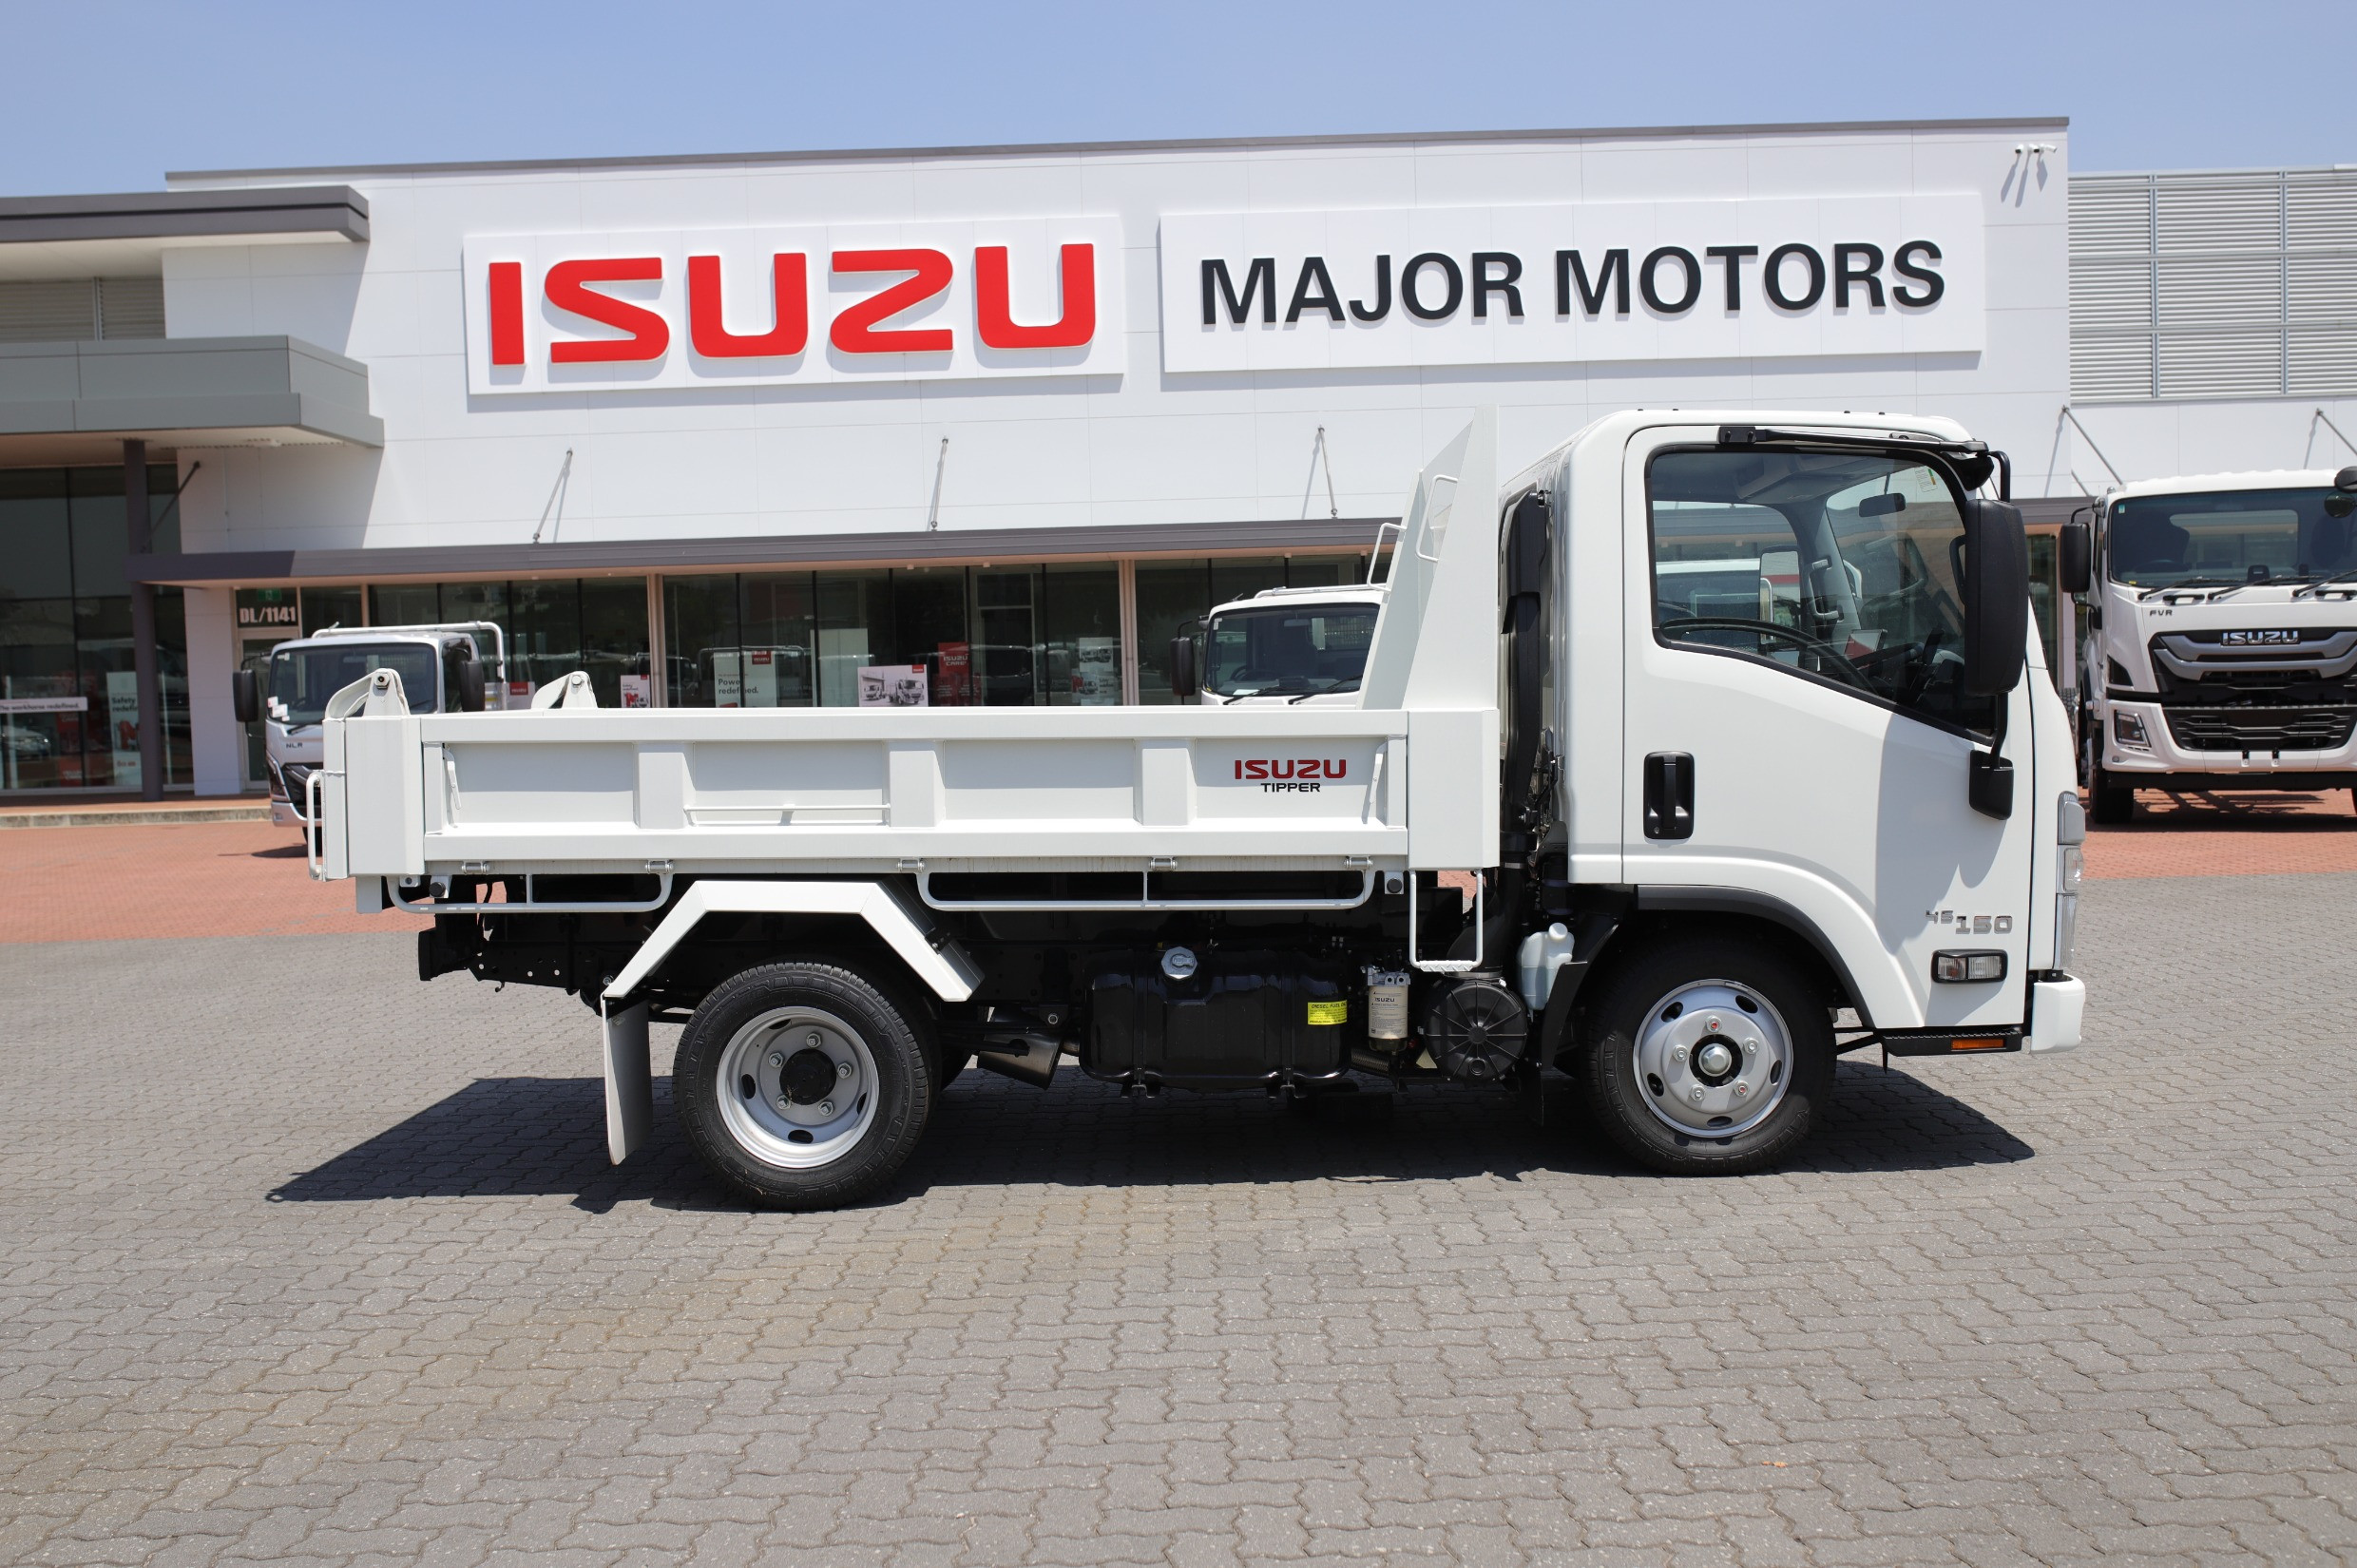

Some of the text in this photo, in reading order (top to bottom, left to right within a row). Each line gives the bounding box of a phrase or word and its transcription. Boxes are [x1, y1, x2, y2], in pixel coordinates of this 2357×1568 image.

[1200, 239, 1945, 325] MAJOR MOTORS
[489, 242, 1096, 365] ISUZU
[240, 606, 296, 623] DL/1141
[2222, 630, 2299, 645] ISUZU
[719, 686, 759, 695] redefed.
[1235, 759, 1347, 779] ISUZU
[1260, 782, 1321, 793] TIPPER
[1955, 915, 2013, 934] 150
